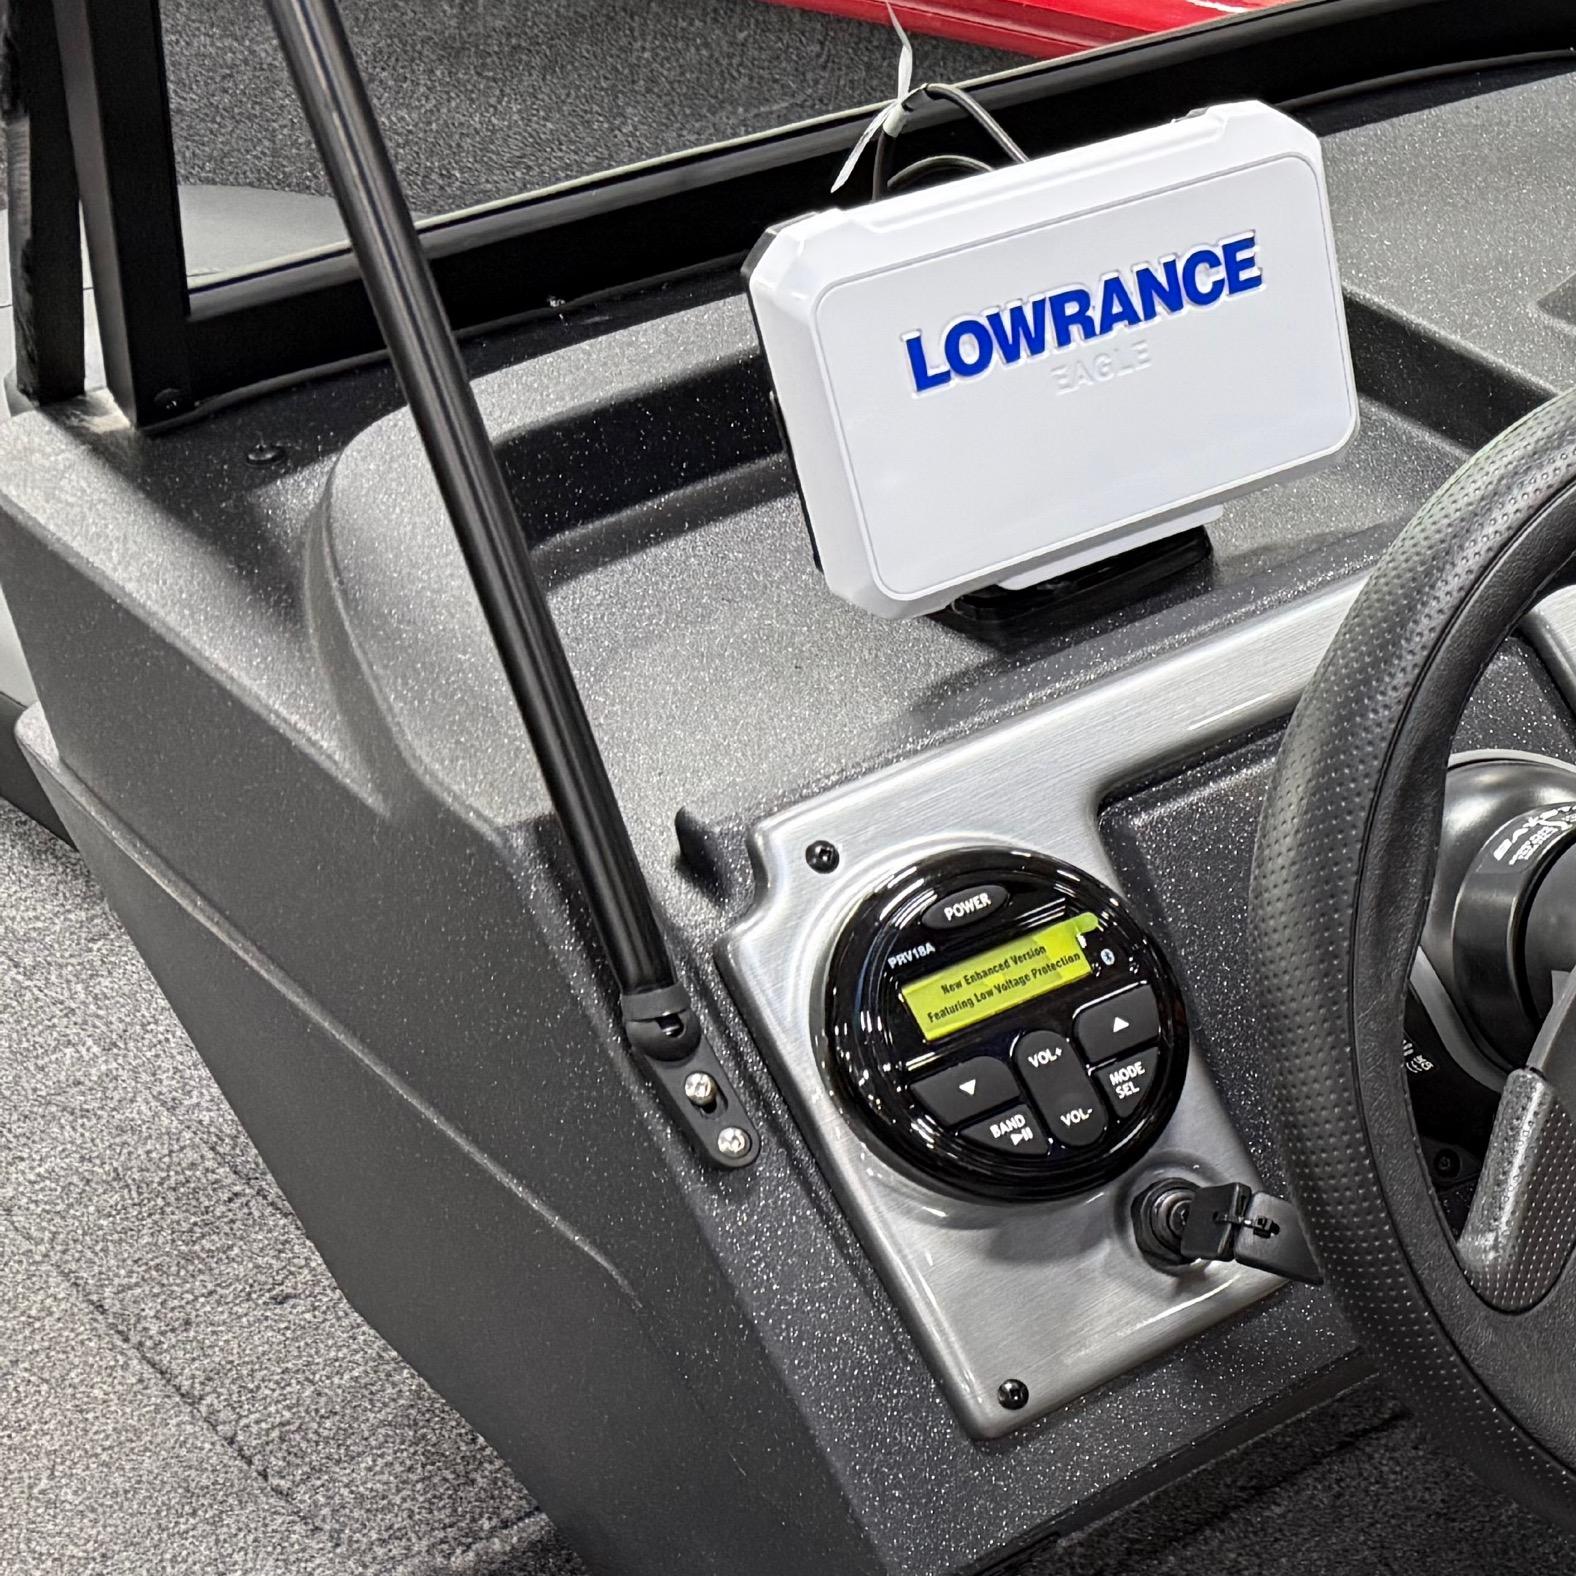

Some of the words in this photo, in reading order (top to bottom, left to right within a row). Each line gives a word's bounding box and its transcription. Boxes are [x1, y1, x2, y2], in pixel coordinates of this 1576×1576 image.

[904, 234, 1264, 393] LOWRANCE
[1050, 339, 1152, 396] EAGLE
[943, 892, 992, 921] POWER
[887, 941, 936, 969] PRV18A
[941, 977, 963, 995] New
[963, 960, 1010, 986] Enhanced
[1010, 944, 1047, 967] Version
[927, 998, 975, 1024] Featuring
[975, 989, 994, 1005] Low
[994, 971, 1031, 997] Voltage
[1031, 951, 1081, 981] Protection
[1028, 1047, 1063, 1069] VOL+
[1109, 1061, 1145, 1086] MODE
[1115, 1081, 1140, 1099] SEL
[990, 1113, 1026, 1139] BAND
[1060, 1107, 1093, 1127] VOL-
